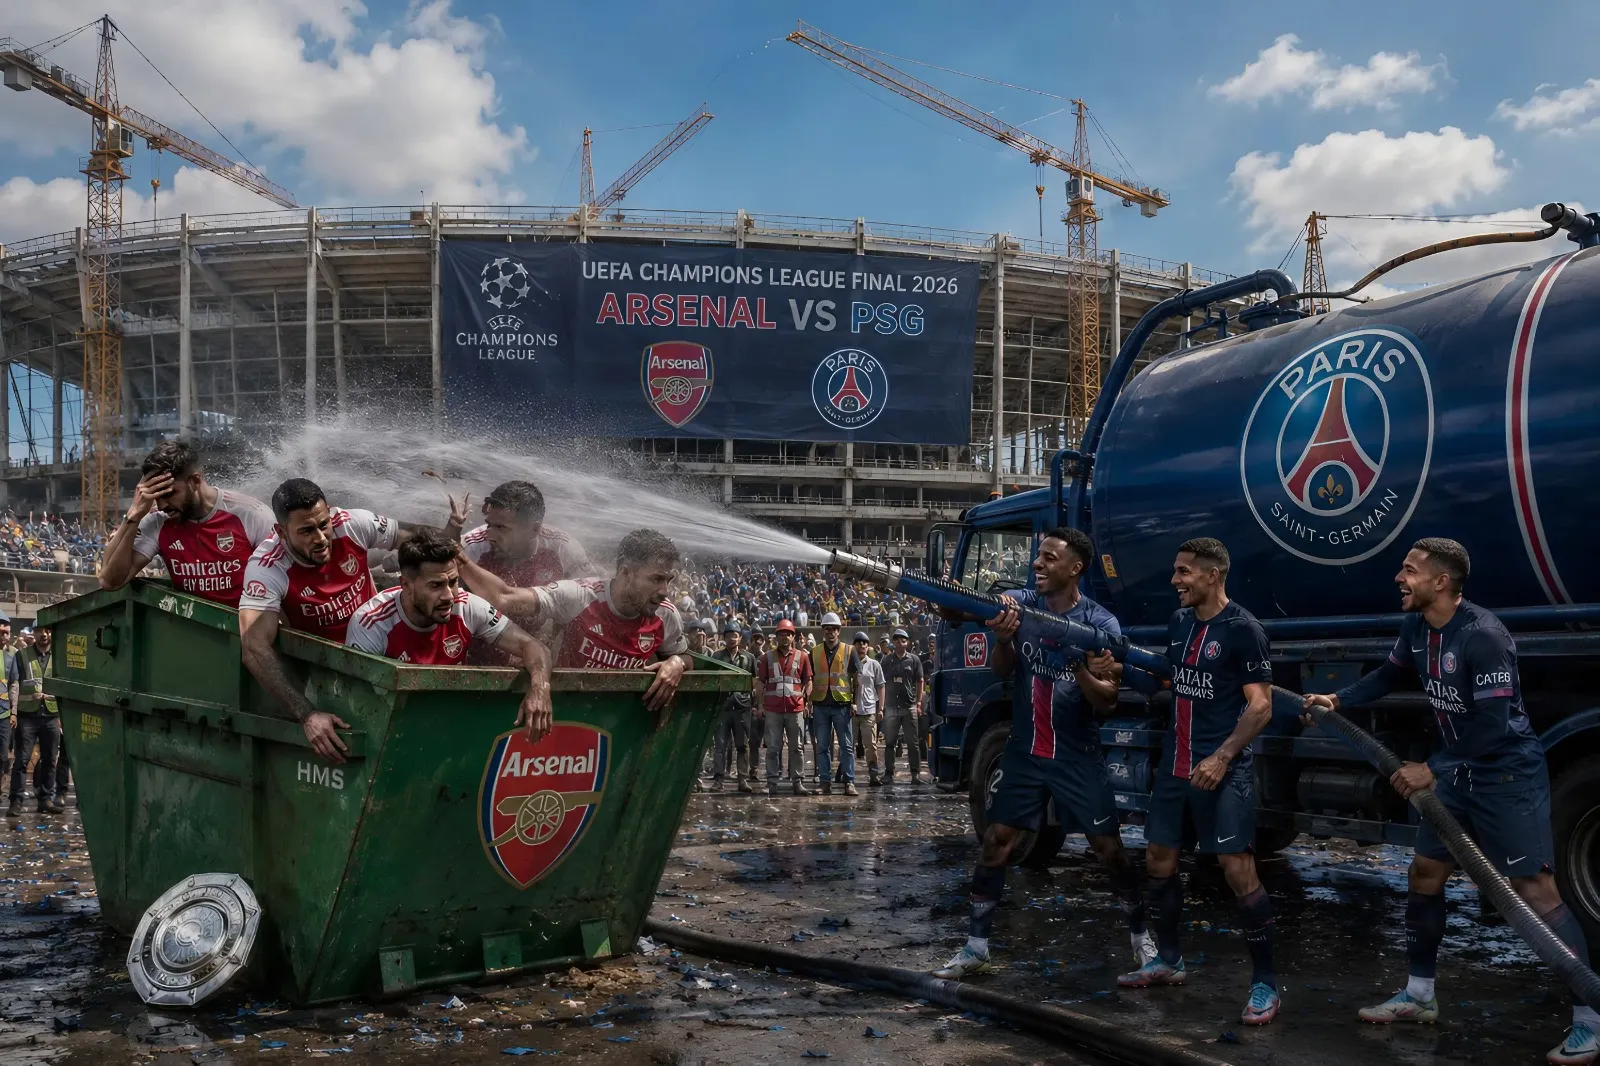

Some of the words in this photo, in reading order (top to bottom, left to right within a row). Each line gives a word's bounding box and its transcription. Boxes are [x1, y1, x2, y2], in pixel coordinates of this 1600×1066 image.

[582, 261, 634, 281] UEFA
[639, 262, 763, 285] CHAMPIONS
[769, 268, 846, 290] LEAGUE
[852, 272, 907, 292] FINAL
[911, 275, 959, 295] 2026
[595, 292, 777, 330] ARSENAL
[788, 298, 837, 332] VS
[850, 301, 925, 336] PSG
[456, 332, 558, 347] CHAMPIONS
[478, 349, 536, 360] LEAGUE
[650, 355, 705, 370] Arsenal
[825, 352, 876, 373] PARIS
[1279, 339, 1406, 400] PARIS
[1270, 488, 1399, 545] SAINT-GERMAIN
[170, 558, 241, 576] Emirates
[300, 572, 366, 617] Emirates
[1425, 679, 1462, 702] ATAR
[297, 760, 344, 790] HMS
[501, 749, 595, 777] Arsenal
